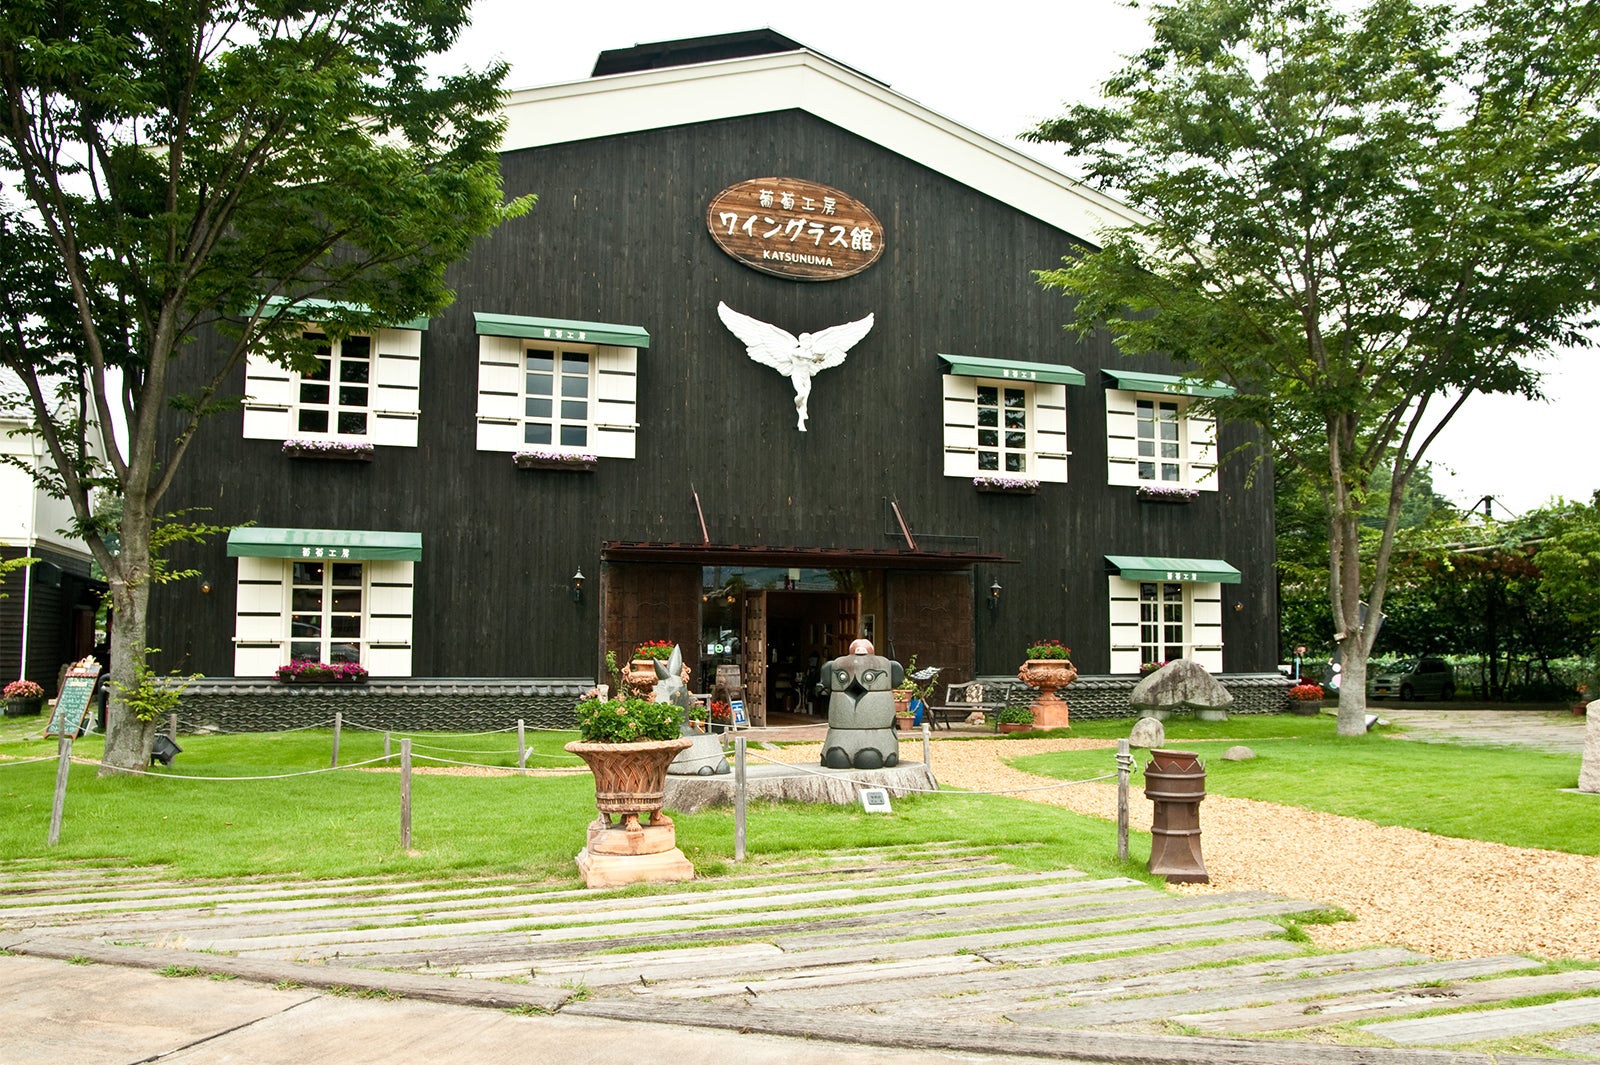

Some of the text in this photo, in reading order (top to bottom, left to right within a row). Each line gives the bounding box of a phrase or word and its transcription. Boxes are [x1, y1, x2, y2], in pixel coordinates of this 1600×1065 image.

[759, 188, 837, 215] 葡萄工房
[719, 211, 874, 252] ワイングラス館
[763, 249, 834, 267] KATSUNUMA
